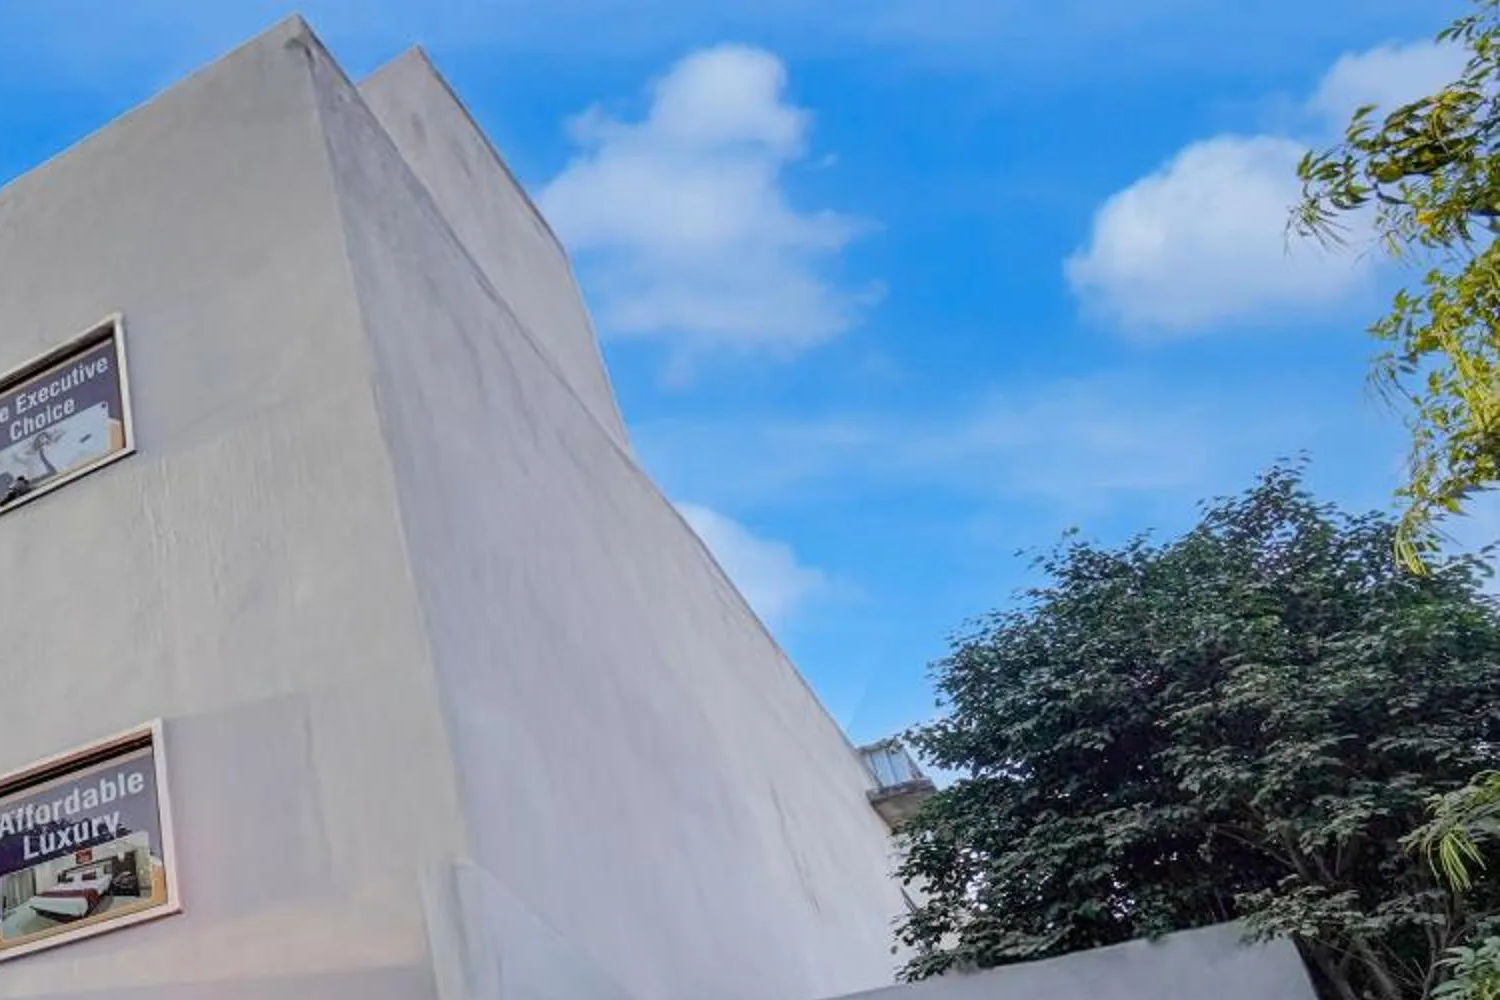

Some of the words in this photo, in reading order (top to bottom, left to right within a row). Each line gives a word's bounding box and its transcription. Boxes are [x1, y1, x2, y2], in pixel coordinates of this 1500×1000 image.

[15, 356, 109, 415] Executive
[9, 398, 76, 441] Choice
[23, 811, 120, 860] Luxury
